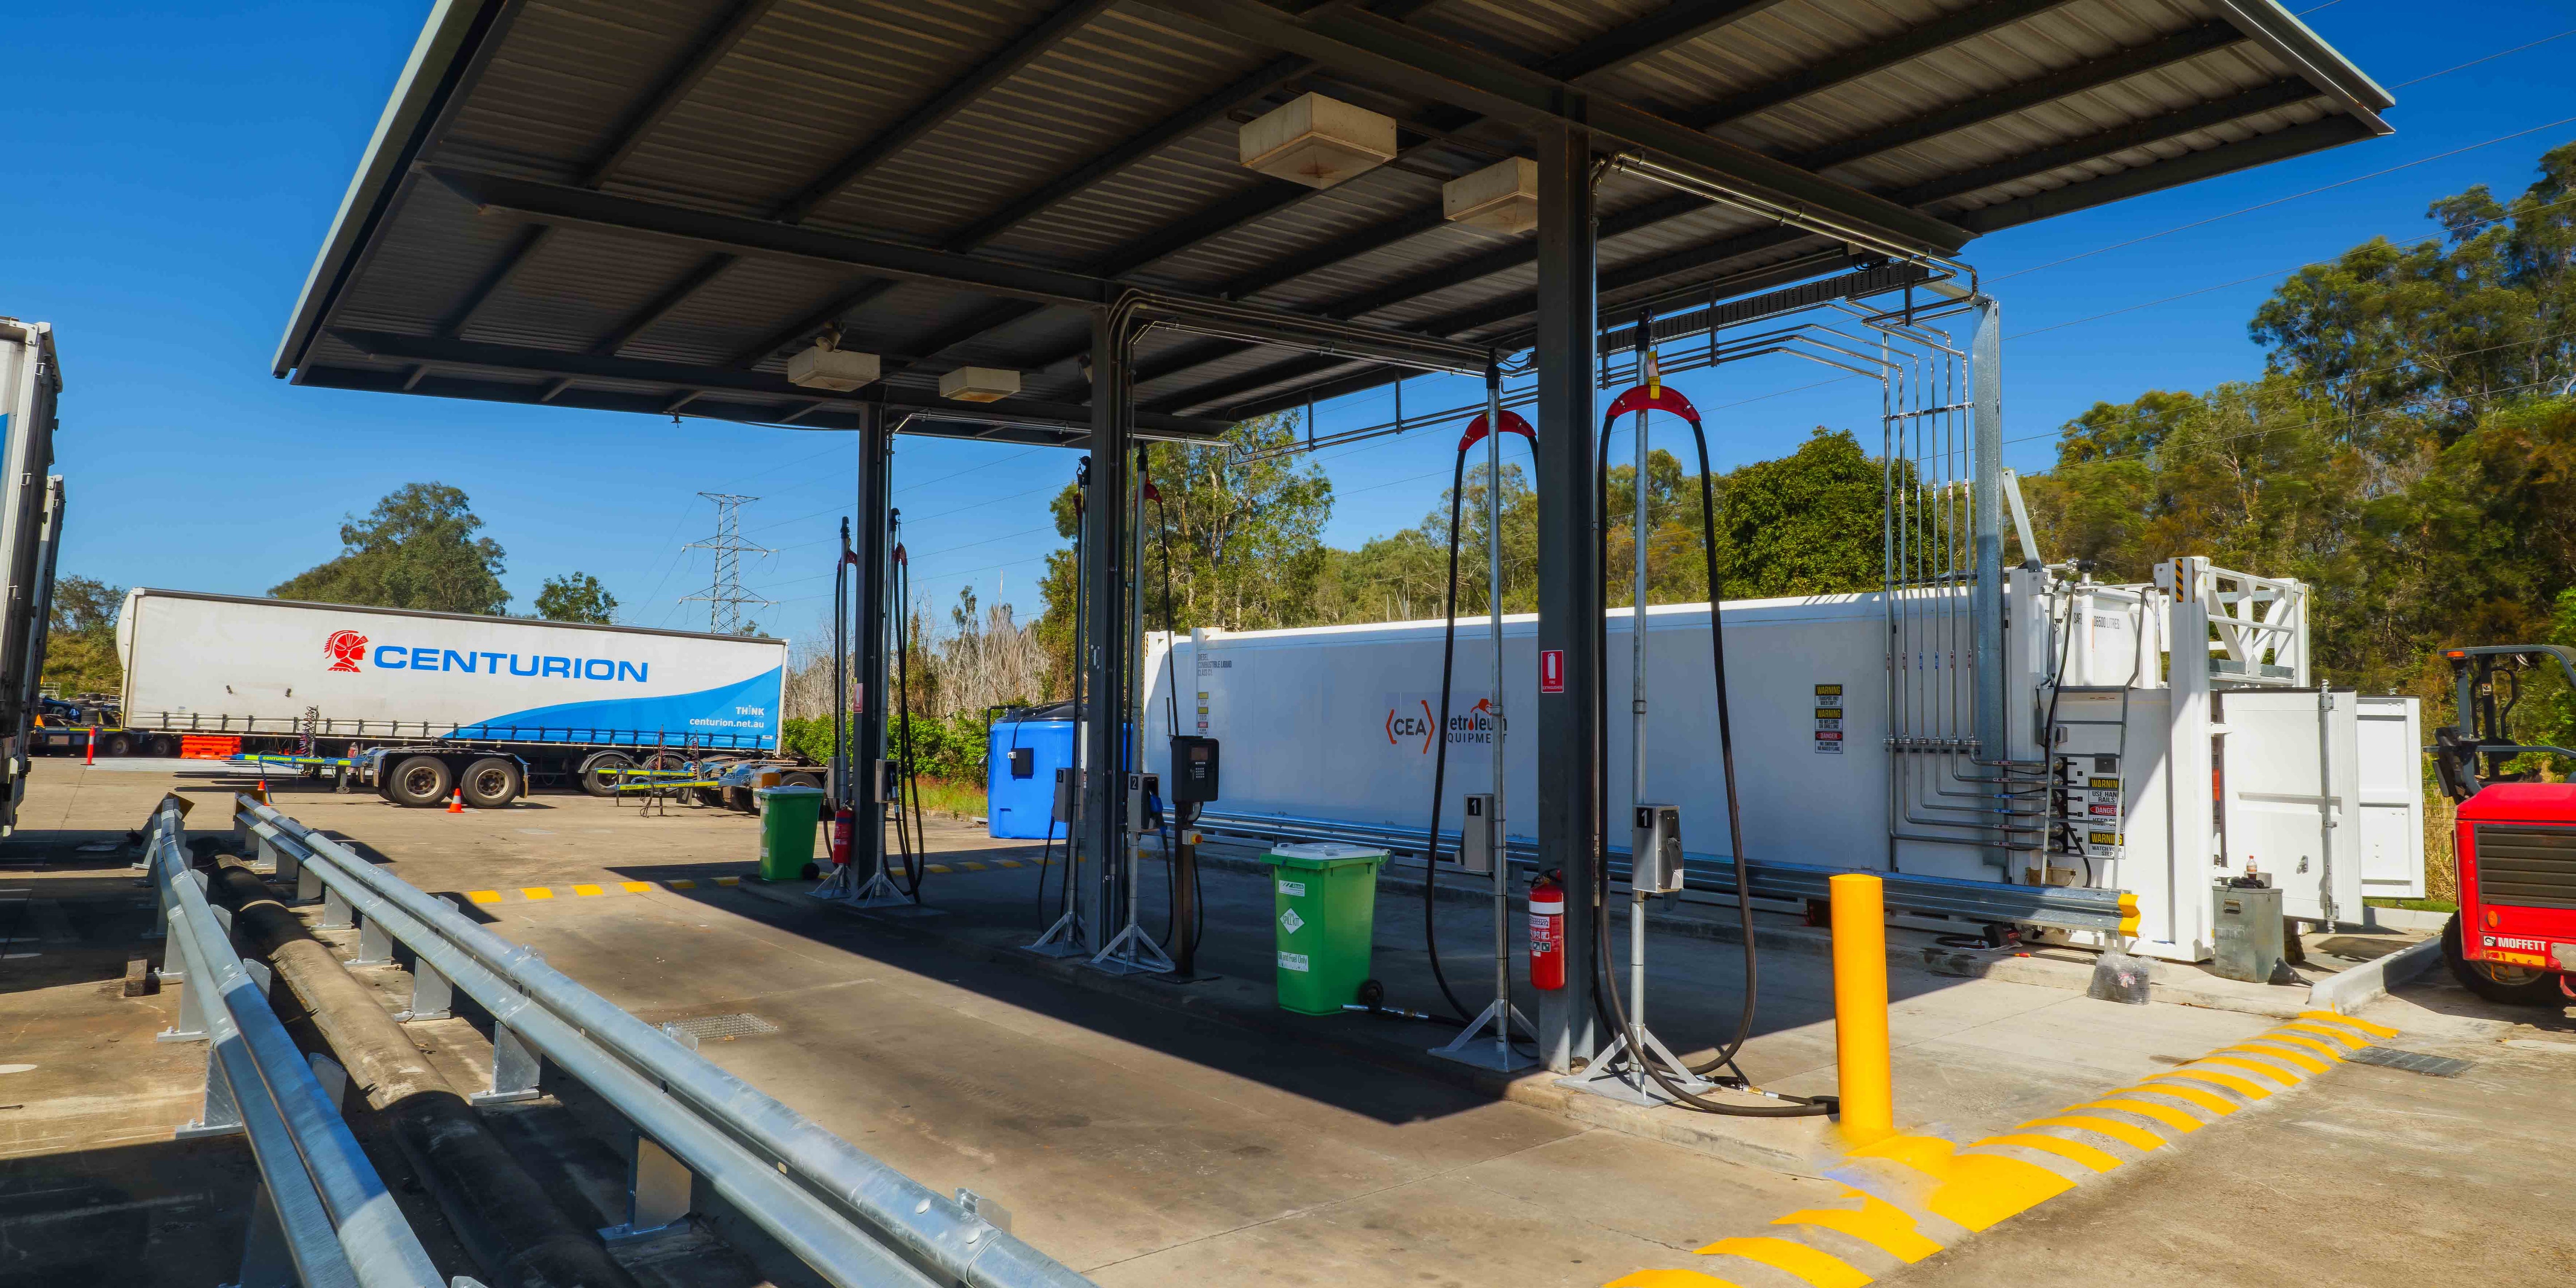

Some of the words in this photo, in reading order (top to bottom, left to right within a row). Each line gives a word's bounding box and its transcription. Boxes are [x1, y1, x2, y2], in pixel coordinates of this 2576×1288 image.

[2074, 613, 2082, 624] SAF
[374, 645, 648, 682] CENTURION
[1817, 686, 1841, 695] WARNING
[1817, 709, 1841, 718] WARNING
[690, 718, 764, 728] centurion.net.au
[1394, 718, 1427, 736] CEA
[1448, 713, 1507, 731] etroleu
[1447, 733, 1507, 743] QUIPMET
[1058, 771, 1062, 781] 3
[1132, 778, 1136, 788] 2
[2092, 779, 2118, 788] WARNIN
[1472, 800, 1477, 814] 1
[1641, 810, 1648, 826] 1
[2092, 833, 2122, 844] WARNIG
[1283, 915, 1292, 925] SPILL
[2498, 937, 2546, 951] MOFFETT
[1289, 953, 1297, 963] Fuel
[1298, 955, 1307, 966] Only
